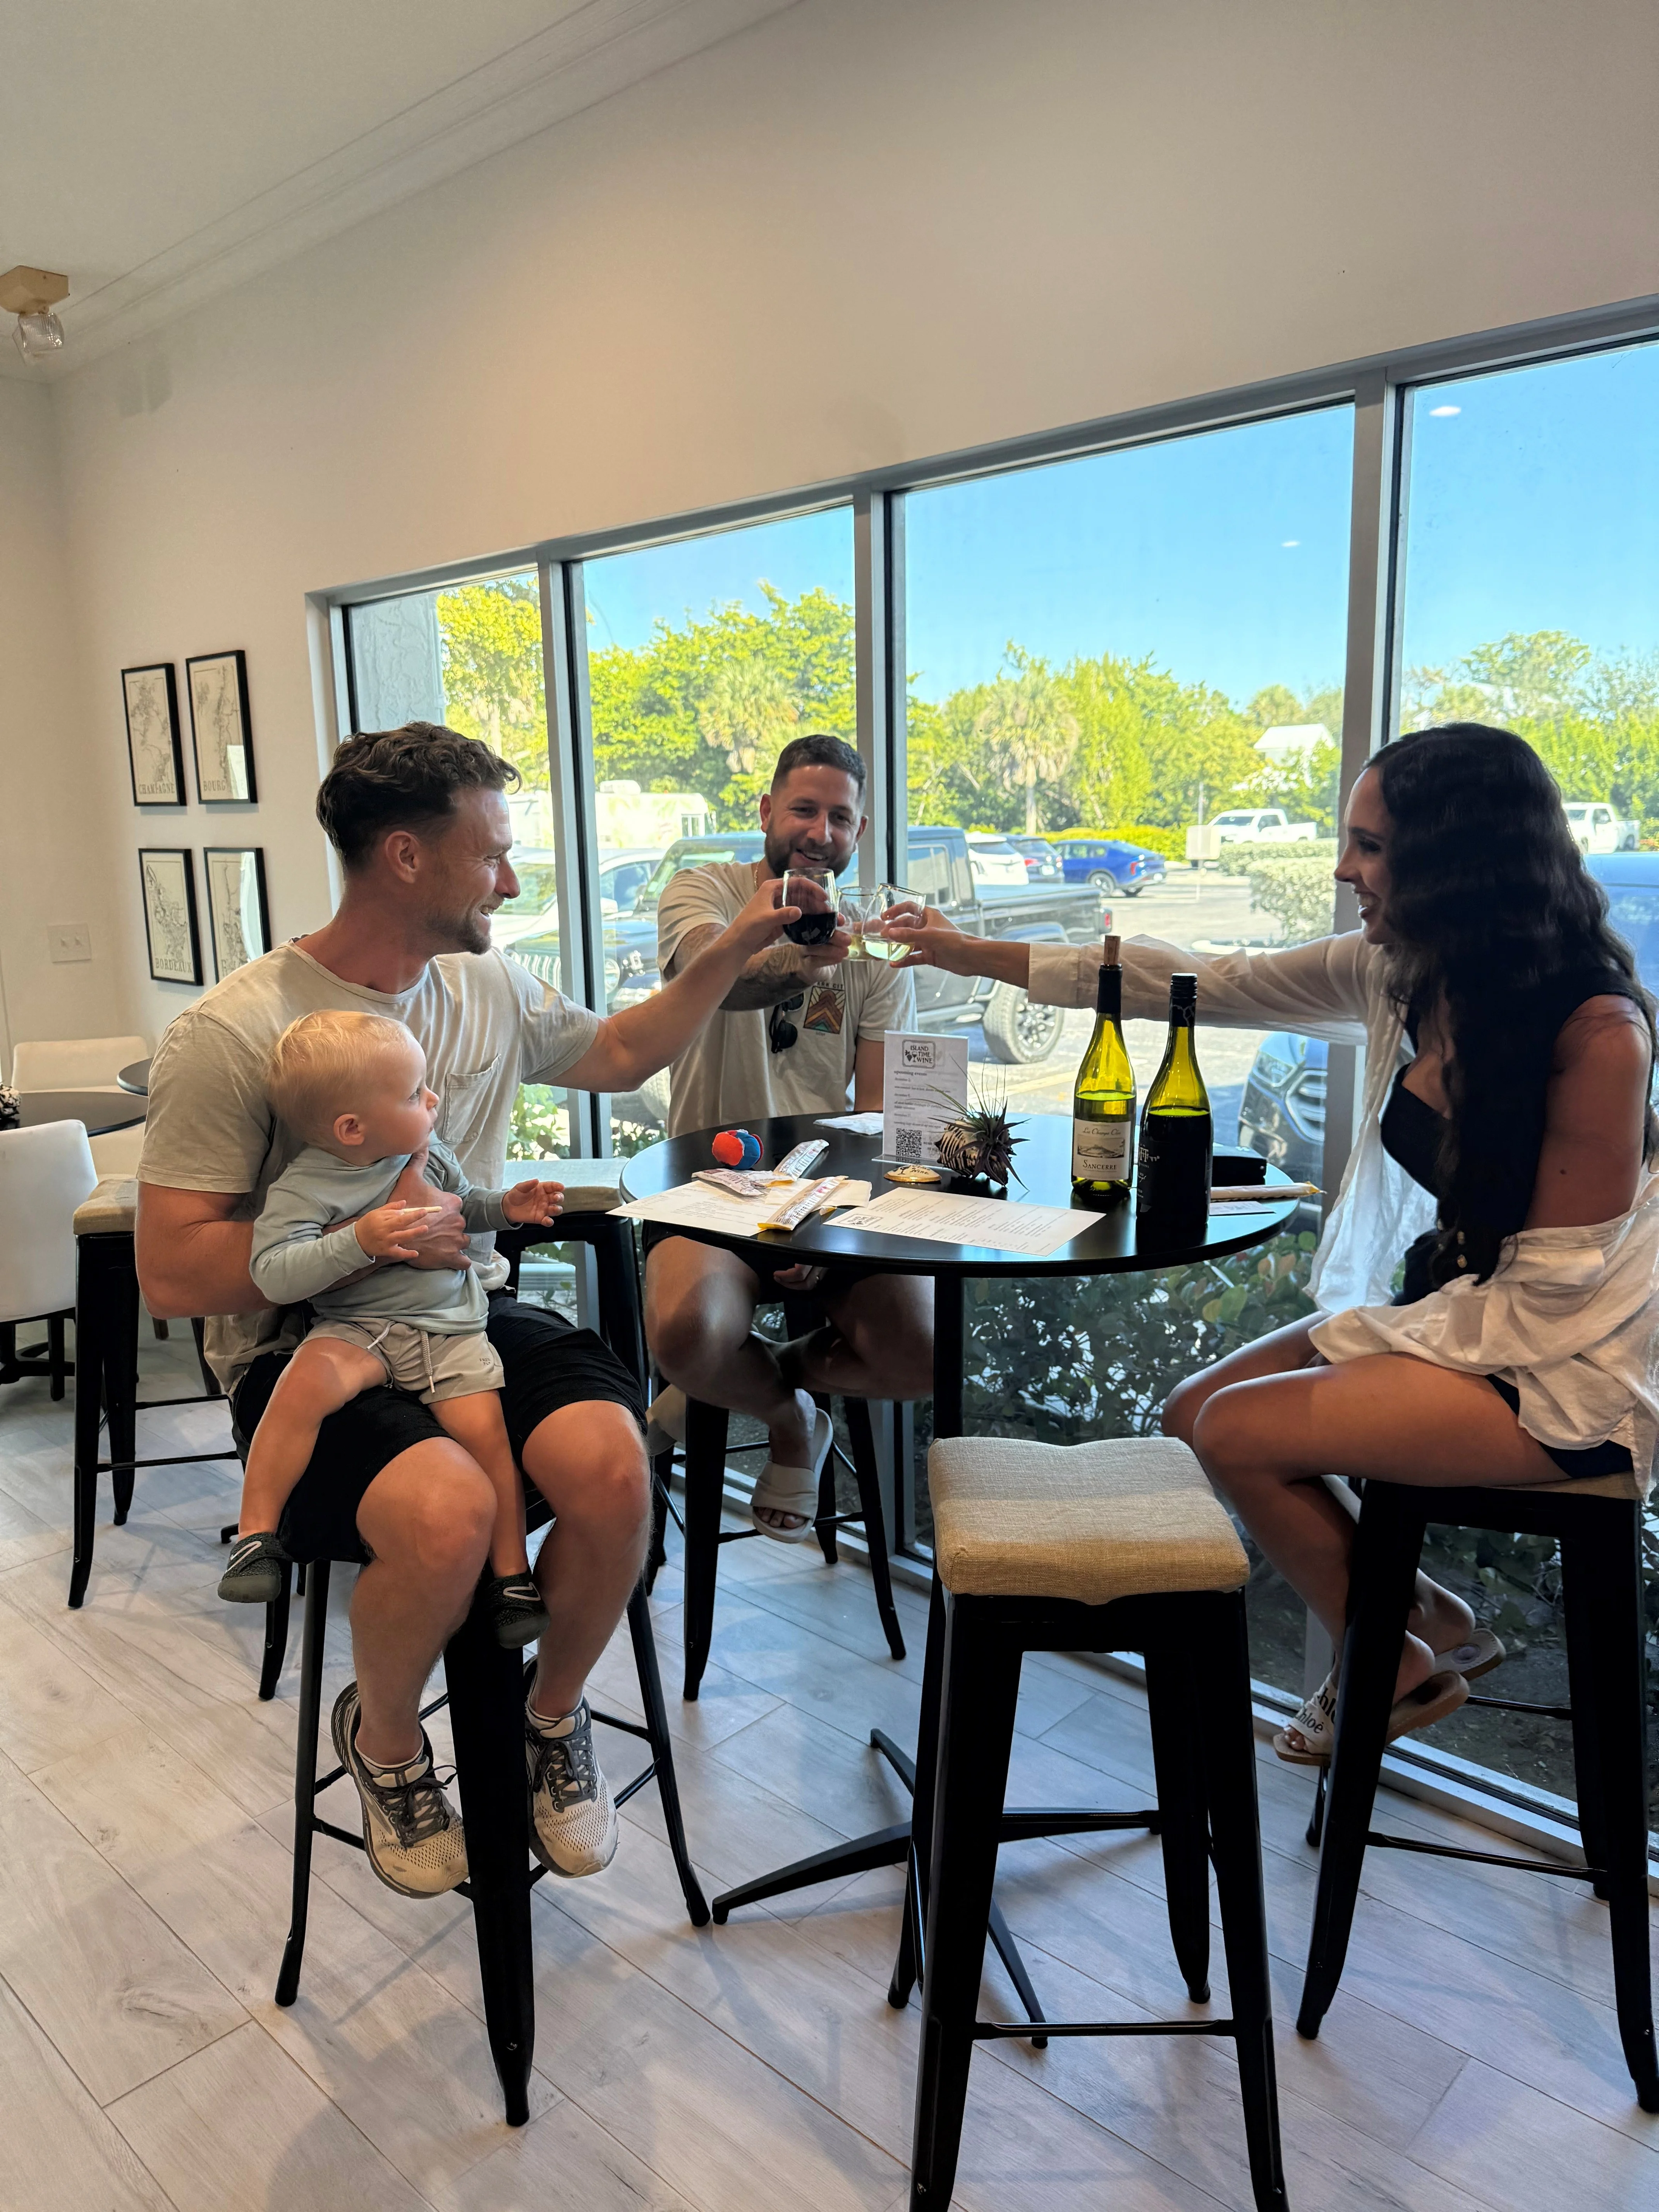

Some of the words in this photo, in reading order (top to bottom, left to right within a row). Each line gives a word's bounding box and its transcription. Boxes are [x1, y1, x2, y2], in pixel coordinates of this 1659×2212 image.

[155, 958, 192, 972] BORDEAUX
[1083, 1159, 1117, 1170] SANCERRE
[1297, 1709, 1324, 1733] hloé
